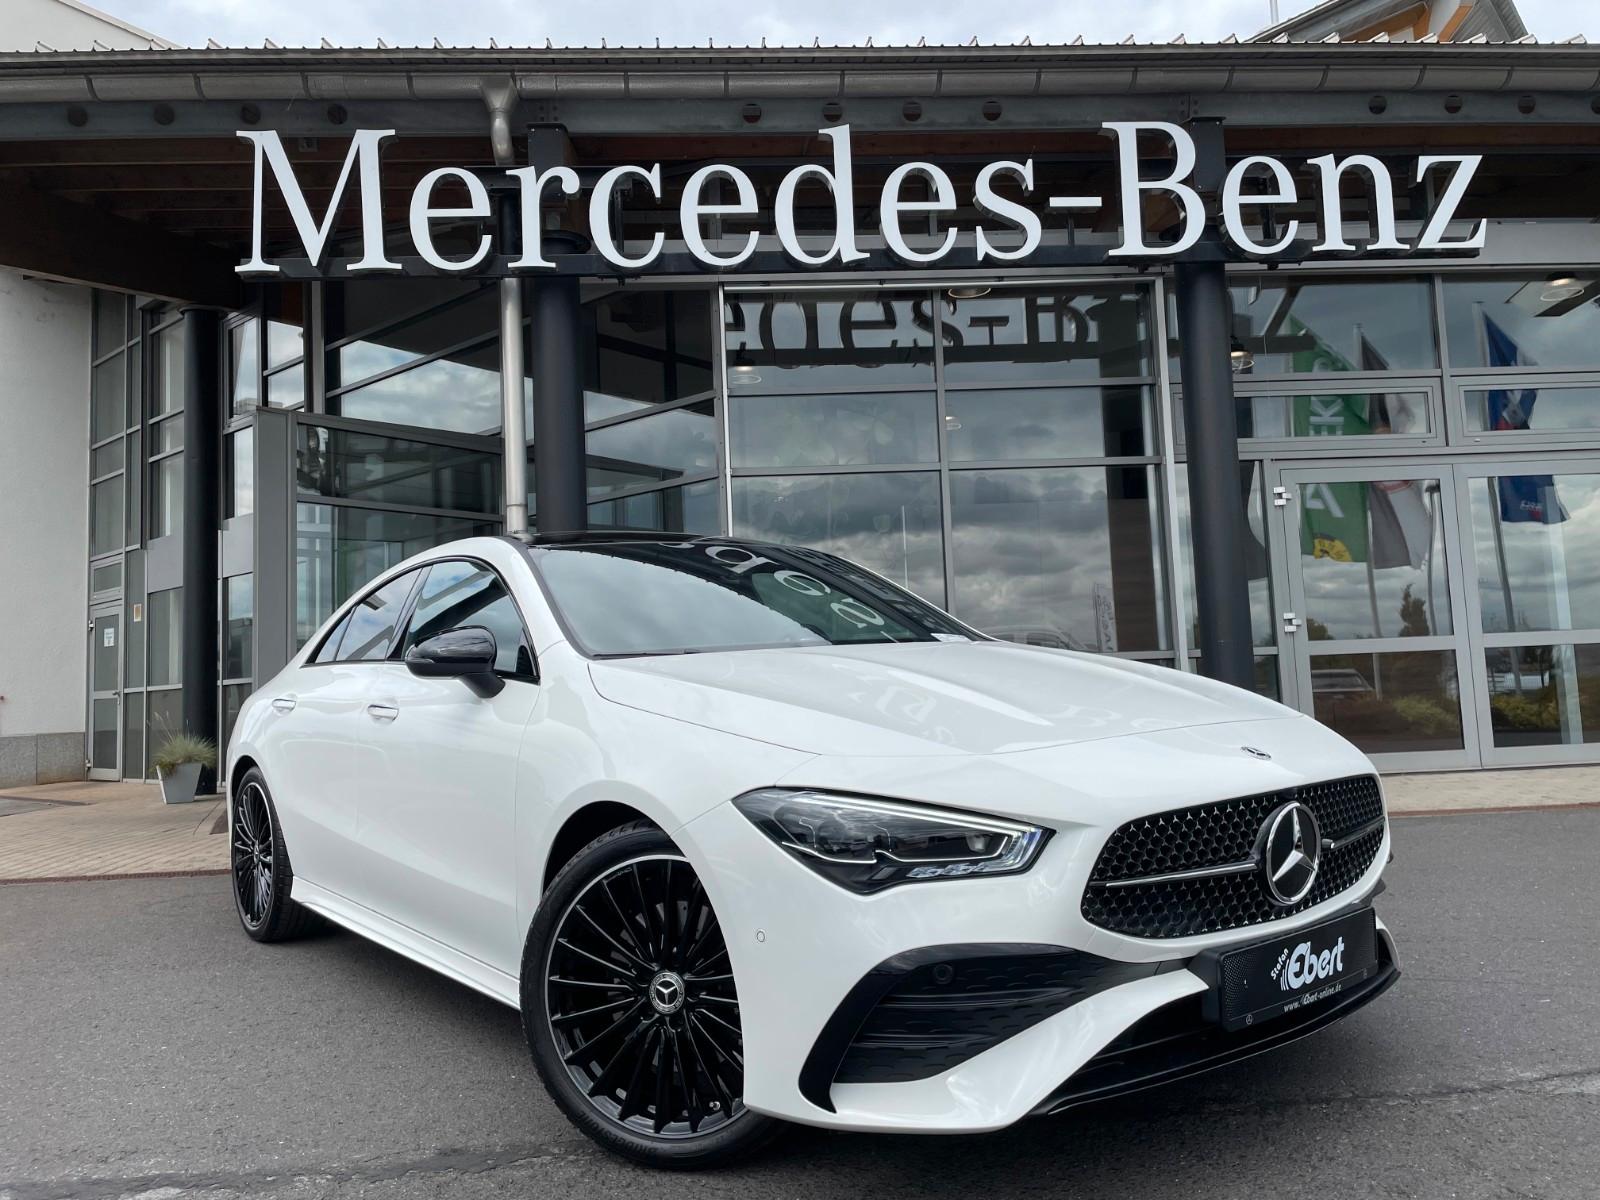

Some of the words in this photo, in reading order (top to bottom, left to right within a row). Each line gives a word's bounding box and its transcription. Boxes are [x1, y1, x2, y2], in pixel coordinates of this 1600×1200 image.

[235, 121, 1487, 273] Mercedes-Benz
[1270, 948, 1289, 980] Stefan
[1287, 936, 1345, 989] Ebert
